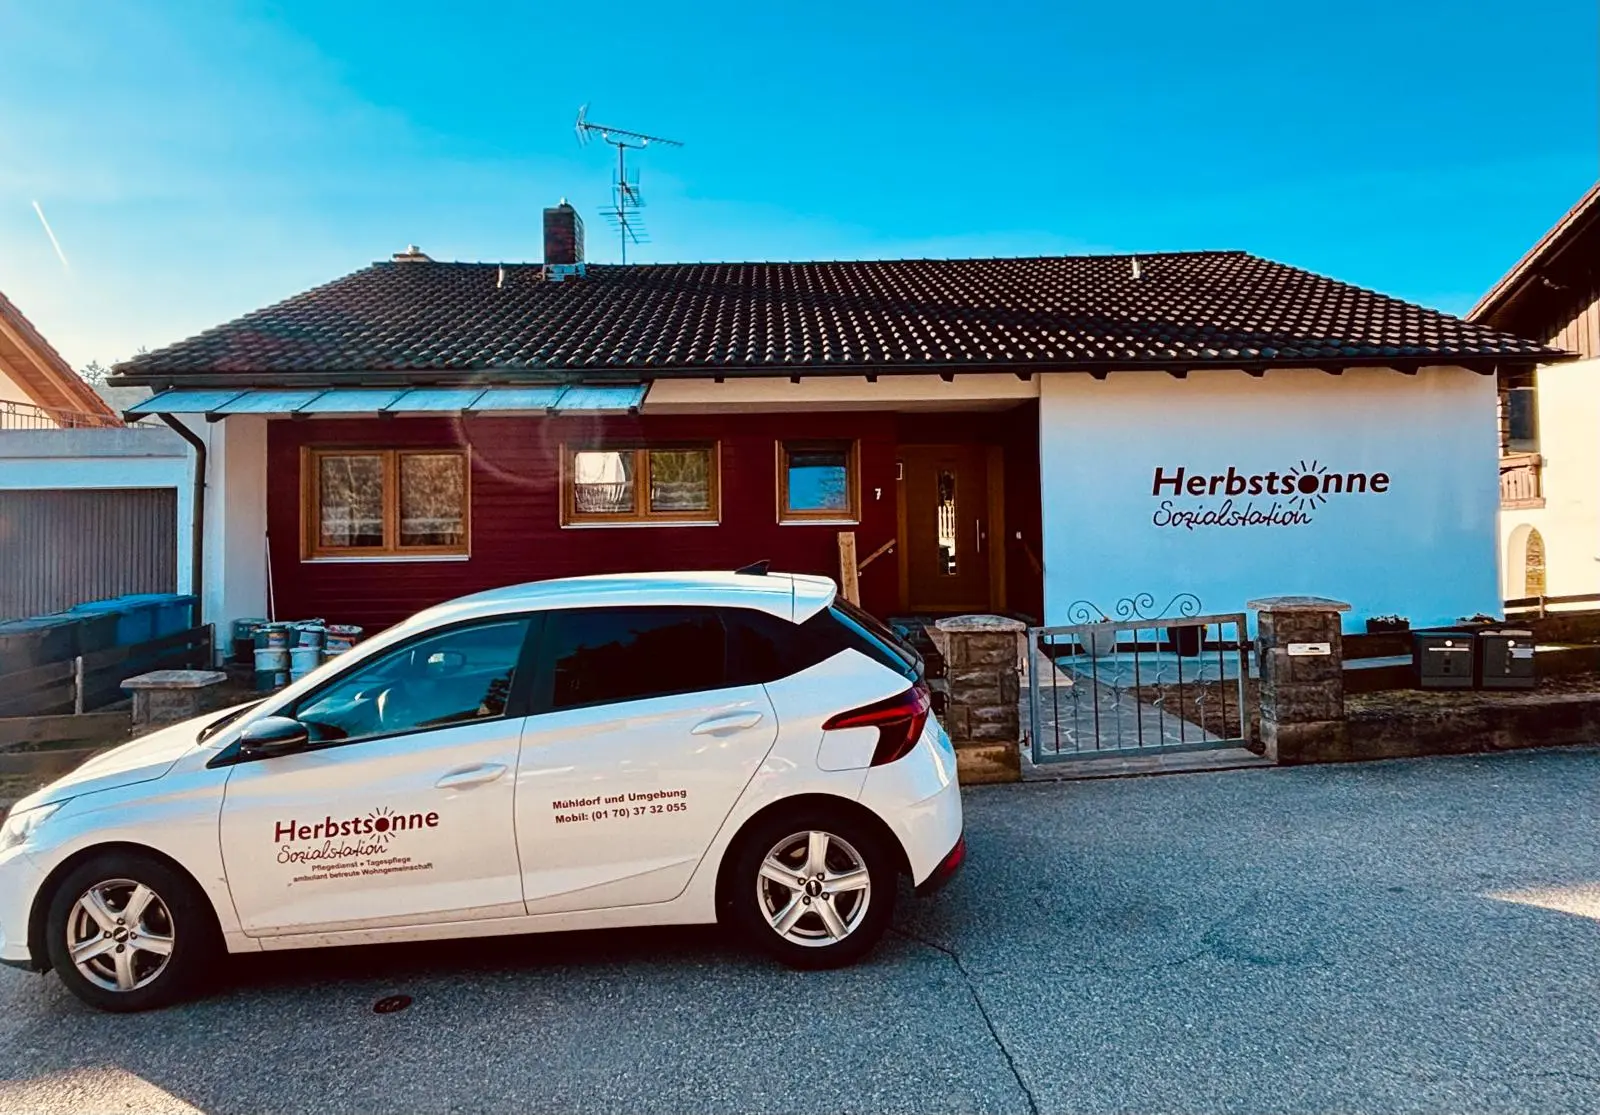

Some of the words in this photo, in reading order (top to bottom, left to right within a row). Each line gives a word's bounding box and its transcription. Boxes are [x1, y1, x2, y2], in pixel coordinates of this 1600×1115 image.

[1152, 466, 1390, 496] Herbstsonne
[874, 487, 882, 500] 7
[1153, 499, 1313, 531] Sozialstation
[552, 796, 601, 810] Mühldorf
[604, 794, 625, 804] und
[628, 789, 687, 802] Umgebung
[555, 812, 589, 824] Mobil:
[591, 810, 609, 822] (01
[611, 808, 630, 819] 70)
[633, 806, 647, 816] 37
[649, 804, 664, 814] 32
[666, 802, 687, 813] 055
[274, 811, 439, 843] Herbstsonne
[277, 840, 388, 864] Sozialstation
[293, 873, 329, 883] ambulant
[329, 869, 361, 879] betreute
[361, 862, 434, 876] Wohngemeinschaft
[311, 861, 359, 872] Pflegedienst
[365, 856, 412, 867] Tagespflege
